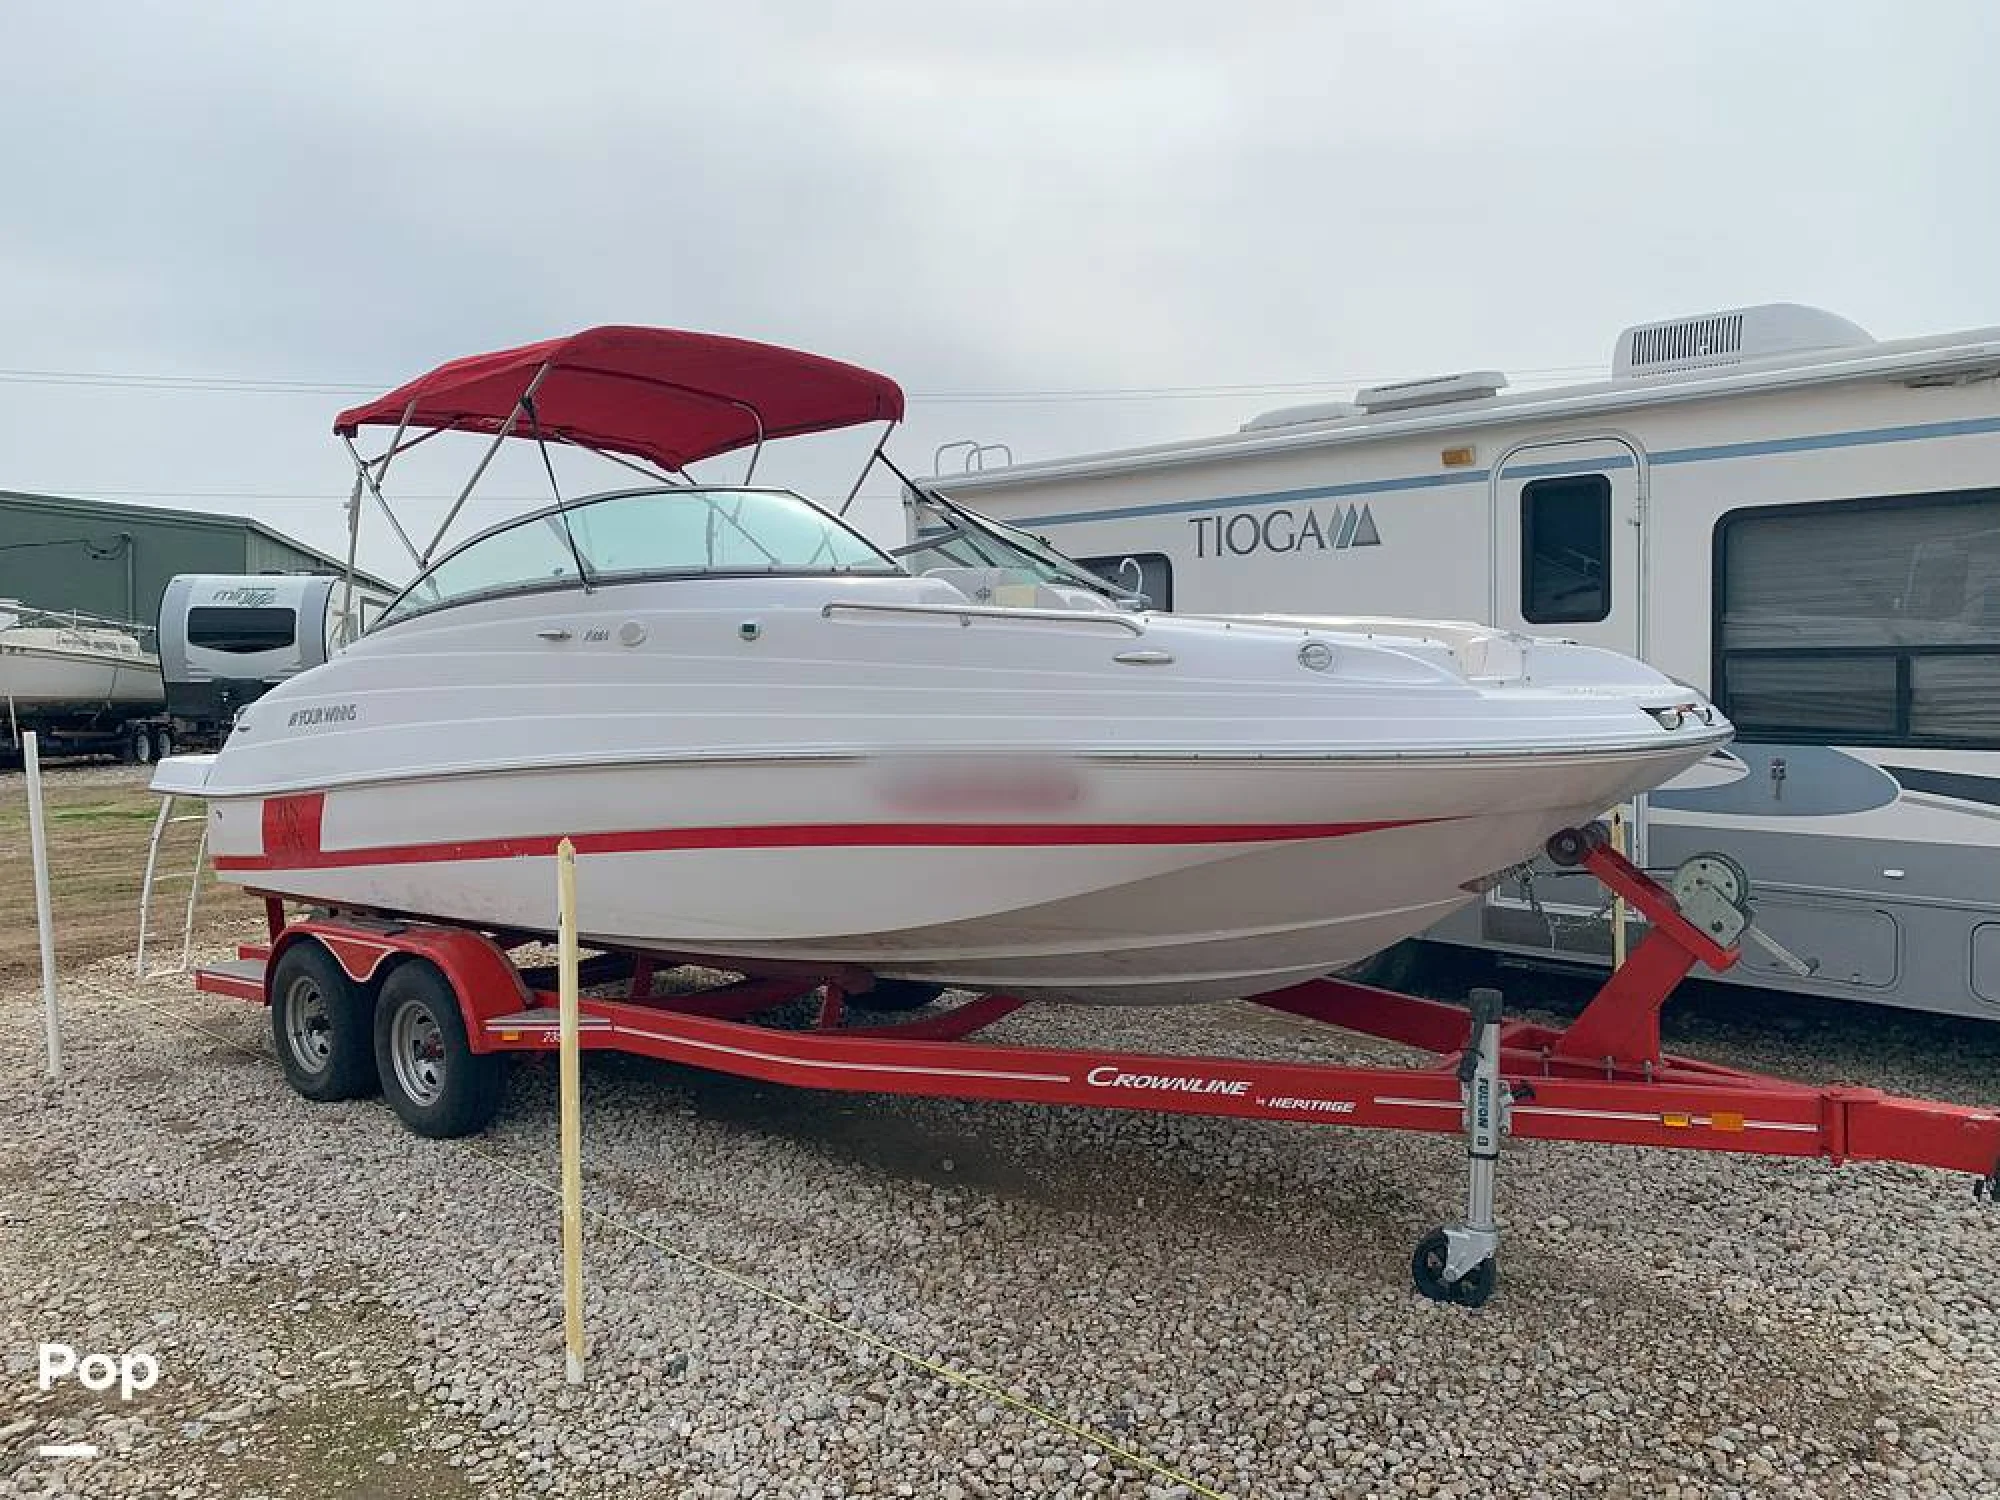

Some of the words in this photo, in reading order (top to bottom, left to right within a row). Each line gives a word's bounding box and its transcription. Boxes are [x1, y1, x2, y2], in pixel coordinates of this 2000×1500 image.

[1188, 506, 1326, 558] TIOGA
[1087, 1066, 1253, 1096] CROWNLINE
[1268, 1097, 1356, 1113] HERITAGE
[1477, 1077, 1489, 1129] FULTON
